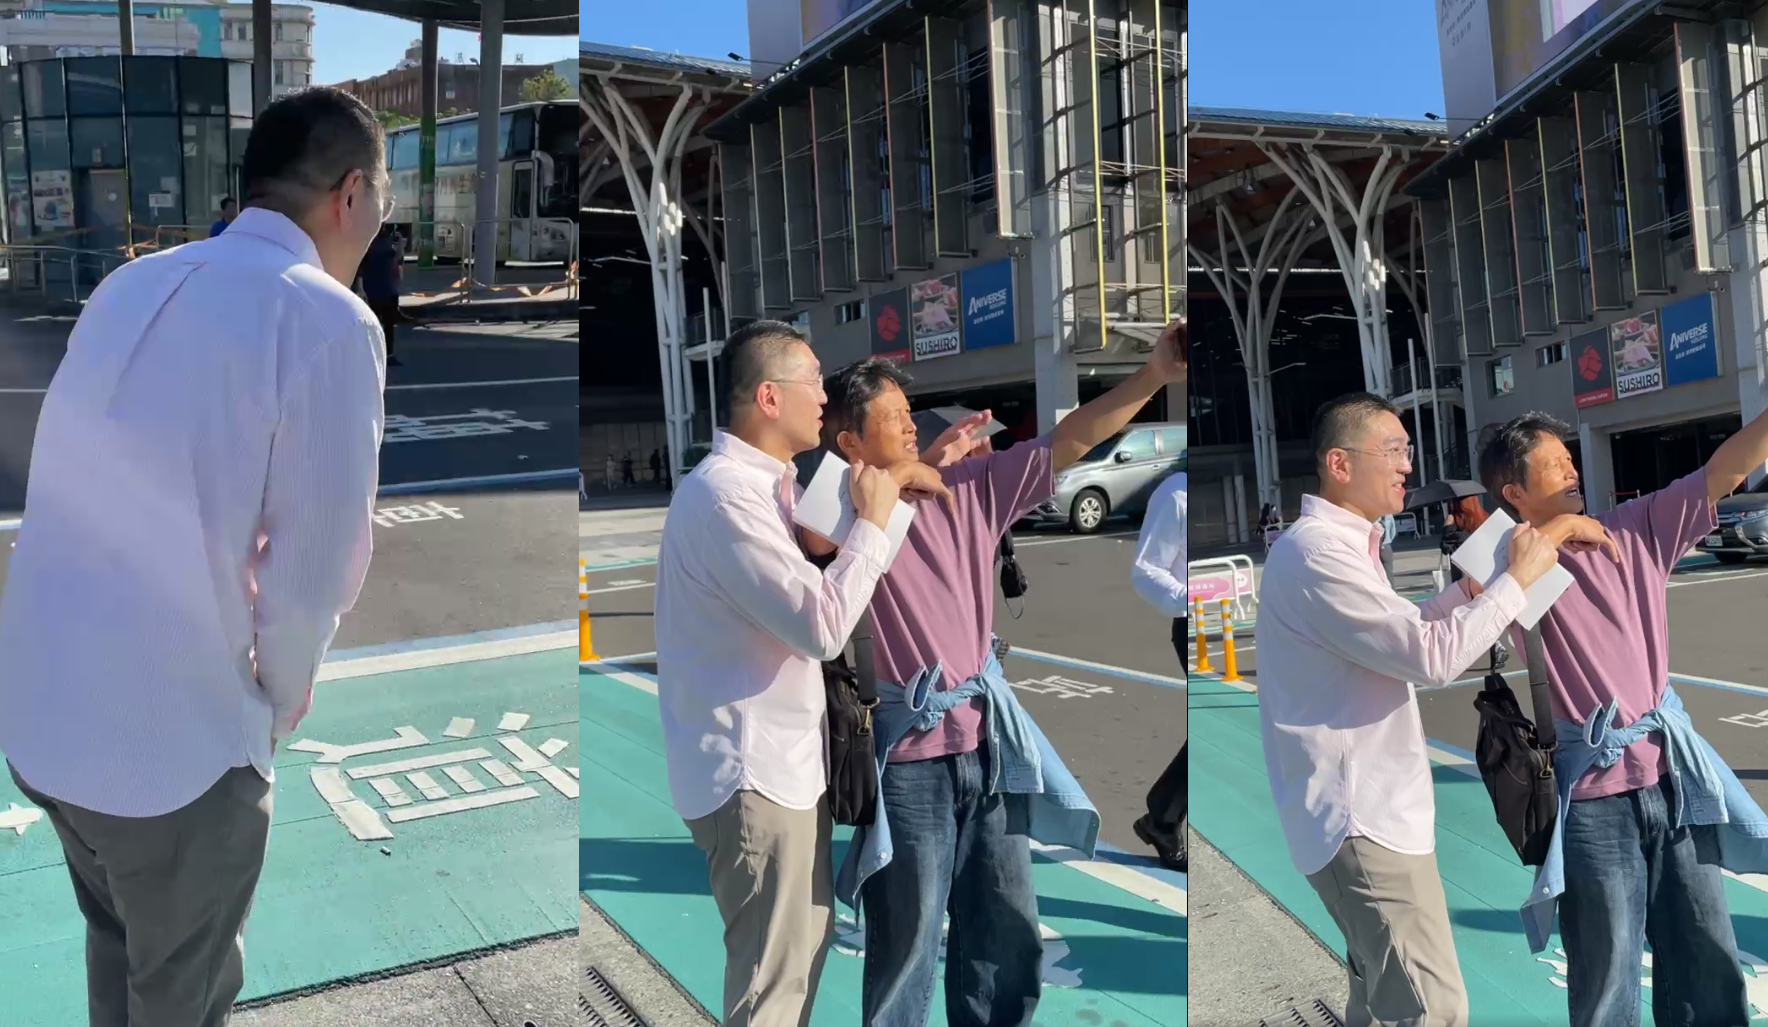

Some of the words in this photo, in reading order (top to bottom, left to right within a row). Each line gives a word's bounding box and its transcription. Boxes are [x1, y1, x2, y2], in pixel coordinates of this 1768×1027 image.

[968, 288, 1007, 316] ANIVERSE
[915, 336, 958, 356] SUSHIRO
[1669, 322, 1708, 352] ANIVERSE
[1618, 372, 1660, 393] SUSHIRO
